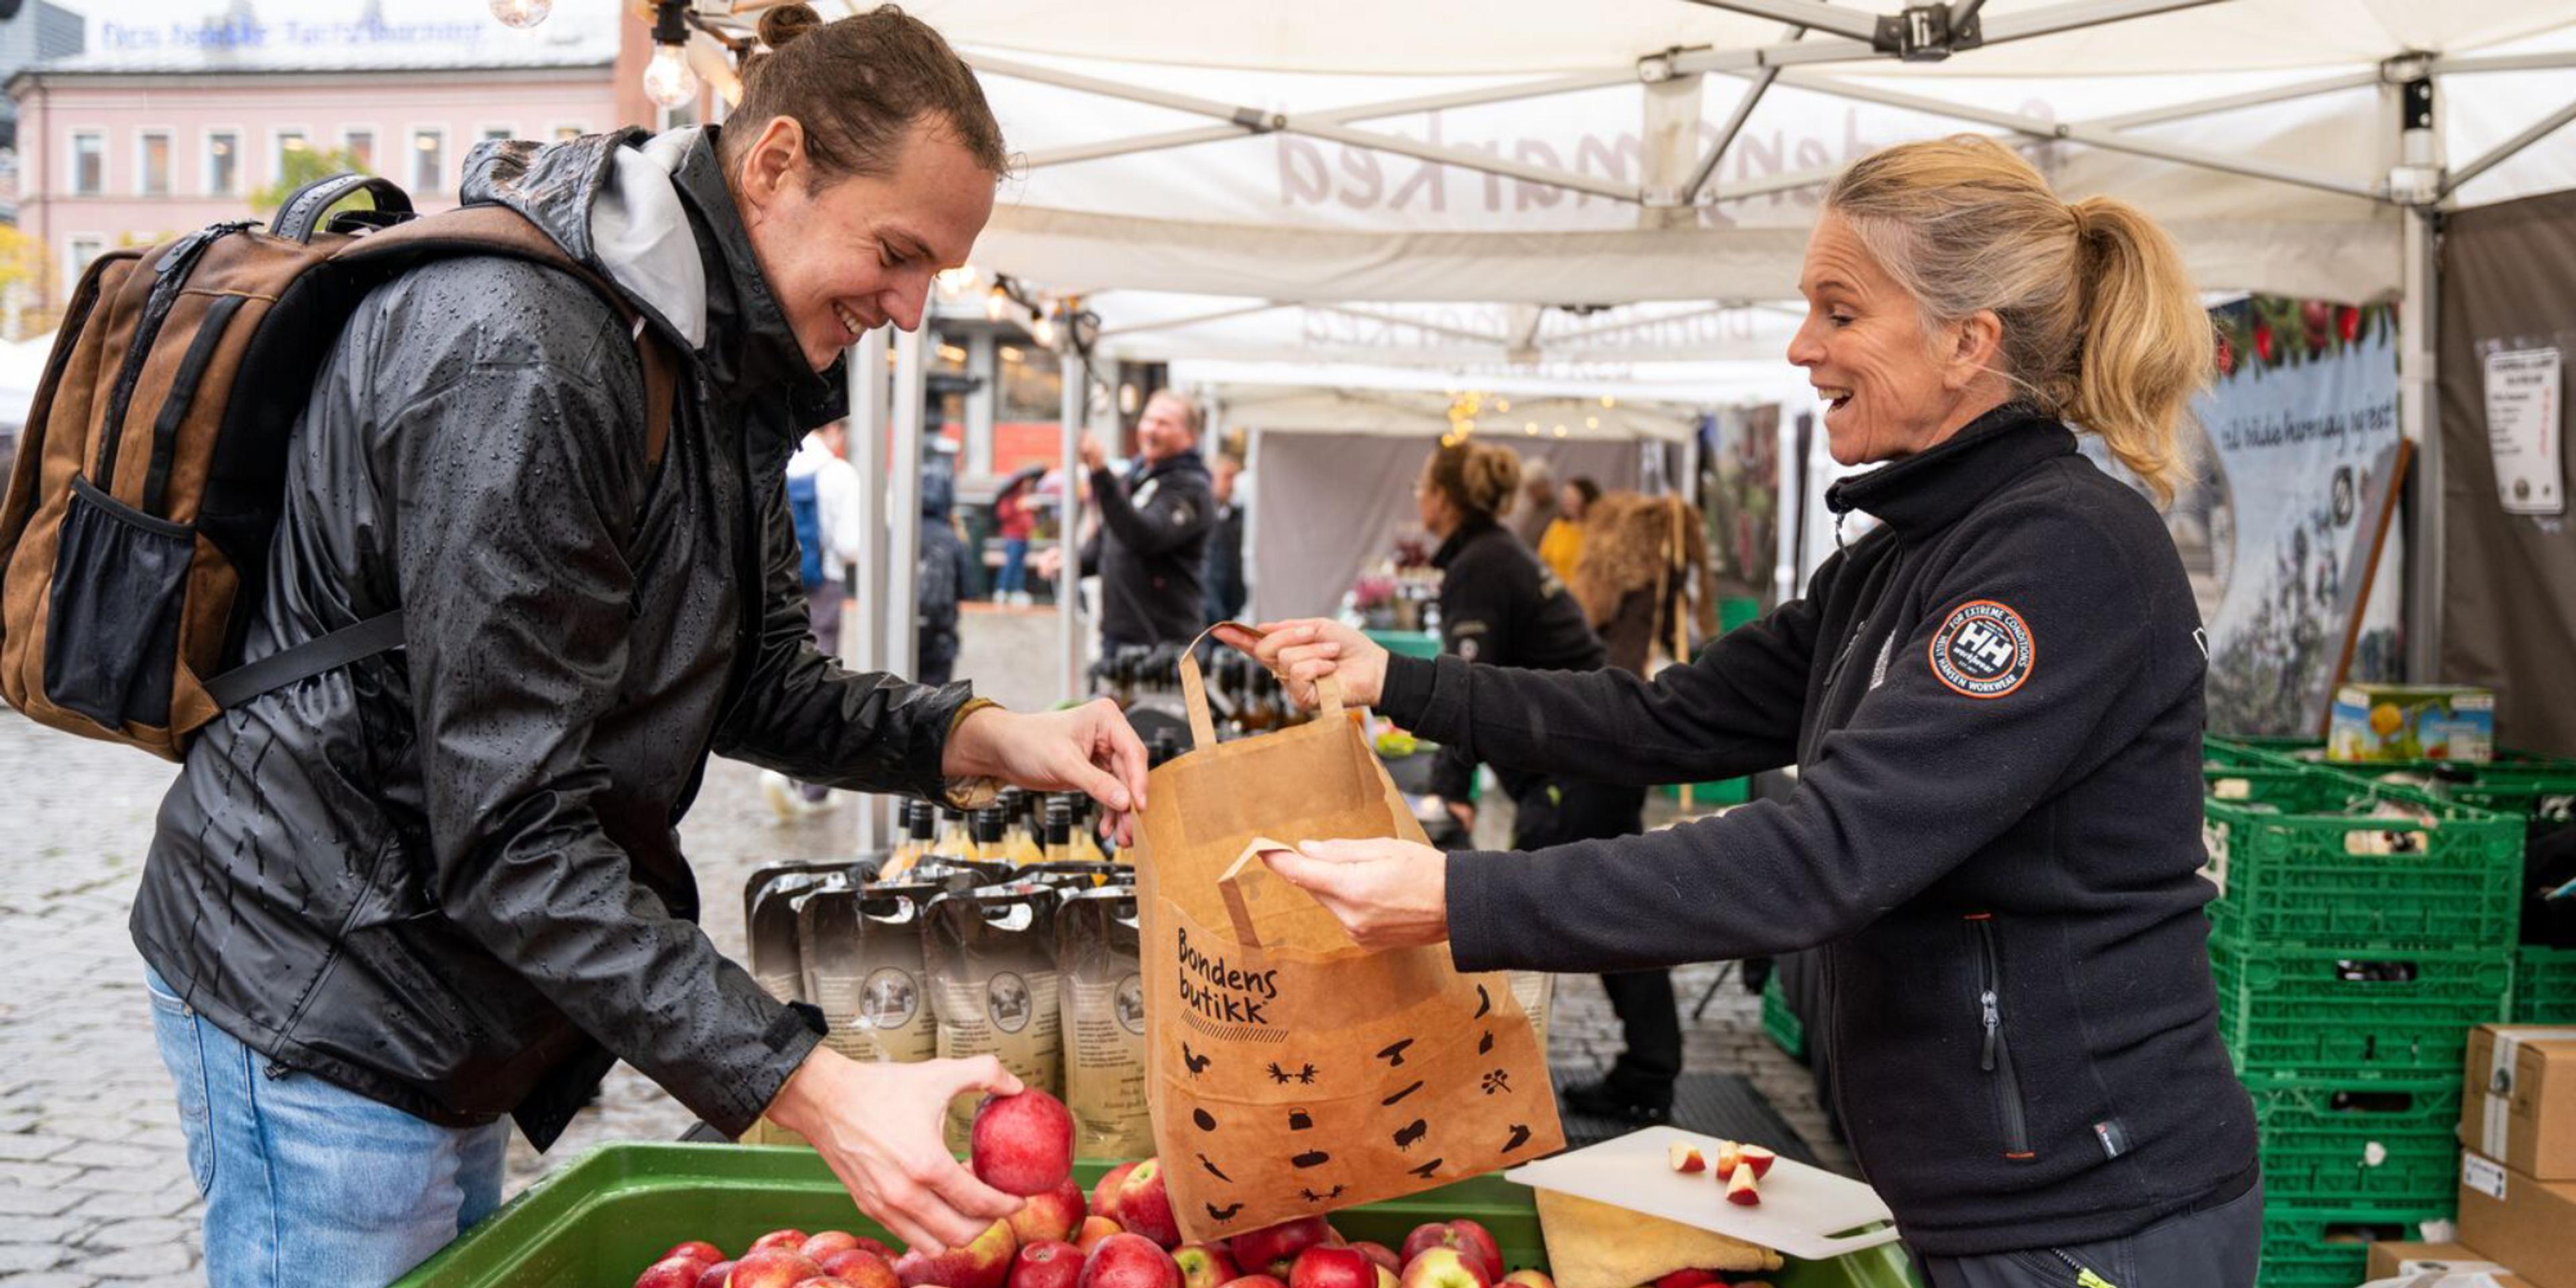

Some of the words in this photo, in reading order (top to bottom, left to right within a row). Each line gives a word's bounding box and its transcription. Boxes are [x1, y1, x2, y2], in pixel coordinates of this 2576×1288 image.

[1949, 613, 1965, 630] FOR
[1964, 606, 2004, 619] EXTREME
[2004, 616, 2030, 668] CONDITIONS
[1957, 621, 2014, 669] HH
[1937, 658, 1968, 688] HANSEN
[1968, 674, 2017, 692] WORKWEAR
[1178, 927, 1278, 999] Bondens
[1179, 966, 1269, 1025] butikk
